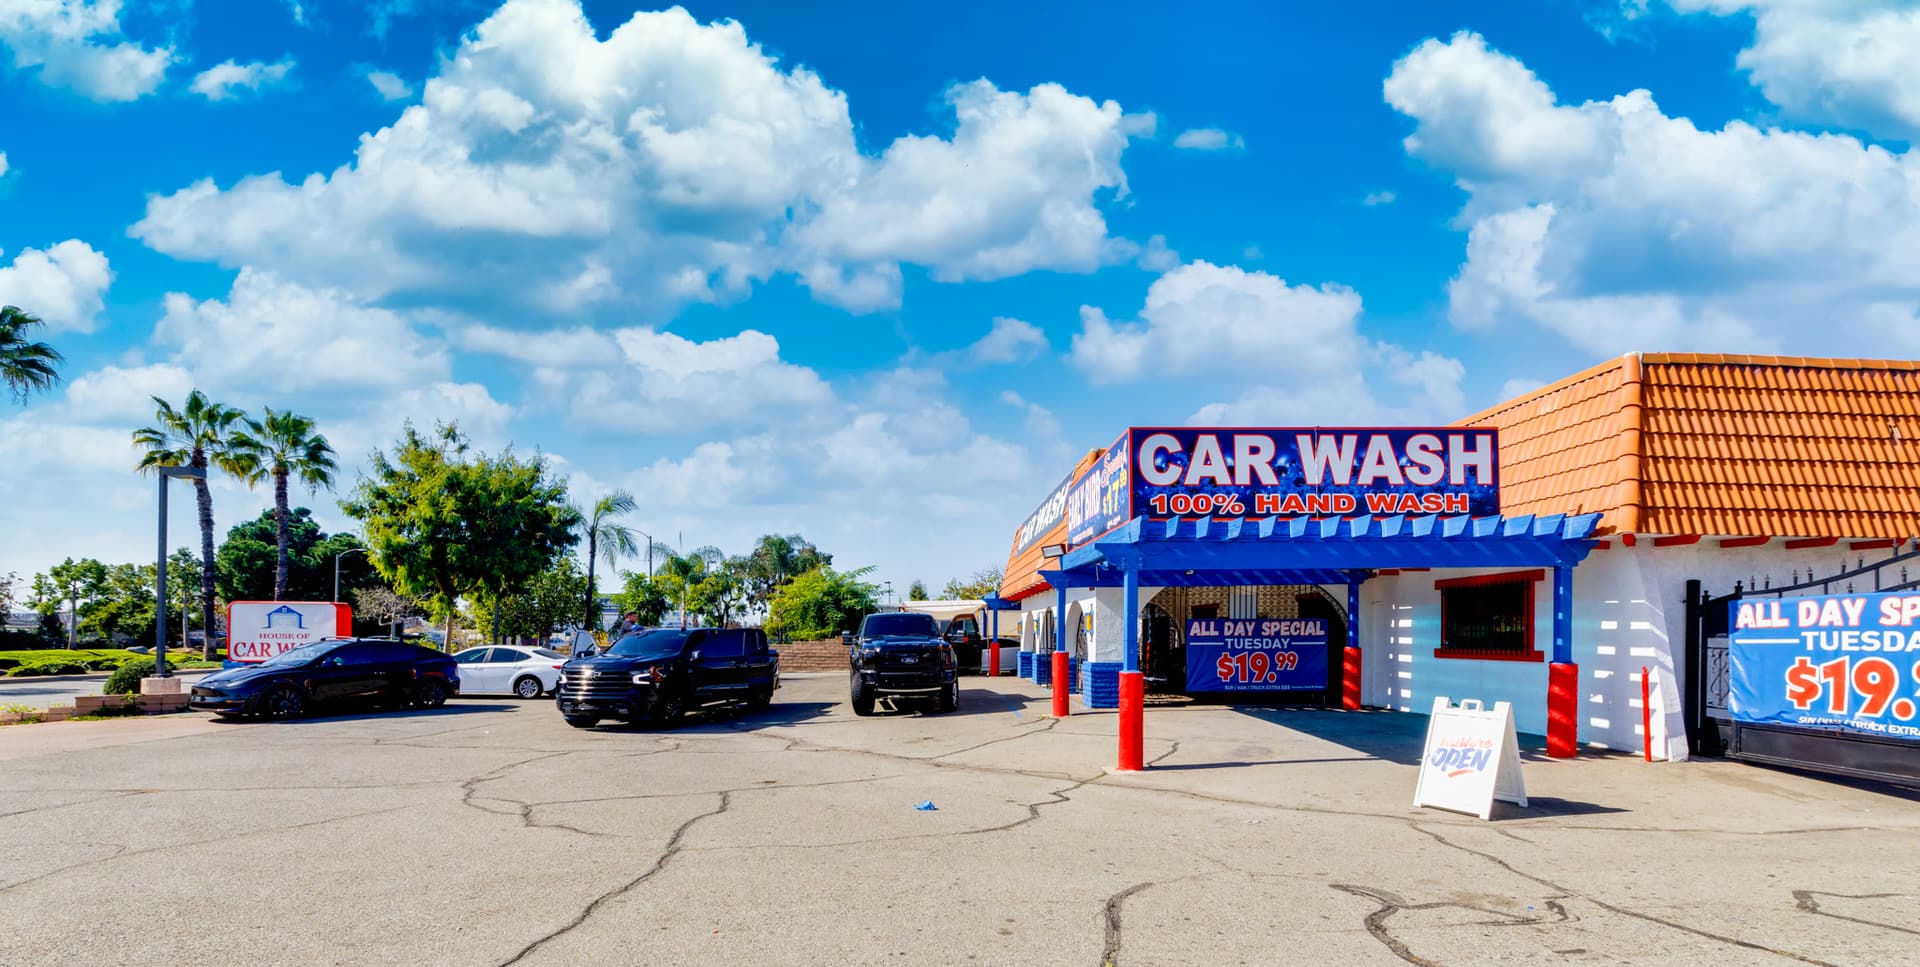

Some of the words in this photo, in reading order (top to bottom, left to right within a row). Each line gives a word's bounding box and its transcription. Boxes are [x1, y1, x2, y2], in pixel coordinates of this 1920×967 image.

[1138, 433, 1280, 486] CAR
[1296, 433, 1494, 486] WASH
[1068, 482, 1085, 532] EARLY
[1085, 469, 1100, 520] BIRD
[1151, 493, 1245, 514] 100%
[1255, 493, 1356, 514] HAND
[1365, 493, 1469, 514] WASH
[1019, 515, 1037, 551] CAR
[1035, 481, 1071, 536] WASH
[1735, 602, 1790, 629] ALL
[1798, 598, 1867, 628] DAY
[1190, 621, 1219, 636] ALL
[1223, 621, 1256, 636] DAY
[1261, 621, 1325, 636] SPECIAL
[233, 642, 272, 658] CAR
[1224, 638, 1290, 649] TUESDAY
[1217, 652, 1298, 683] $19.99
[1850, 720, 1887, 733] TRUCK
[1888, 724, 1920, 736] EXTR
[1430, 748, 1492, 772] OPEN
